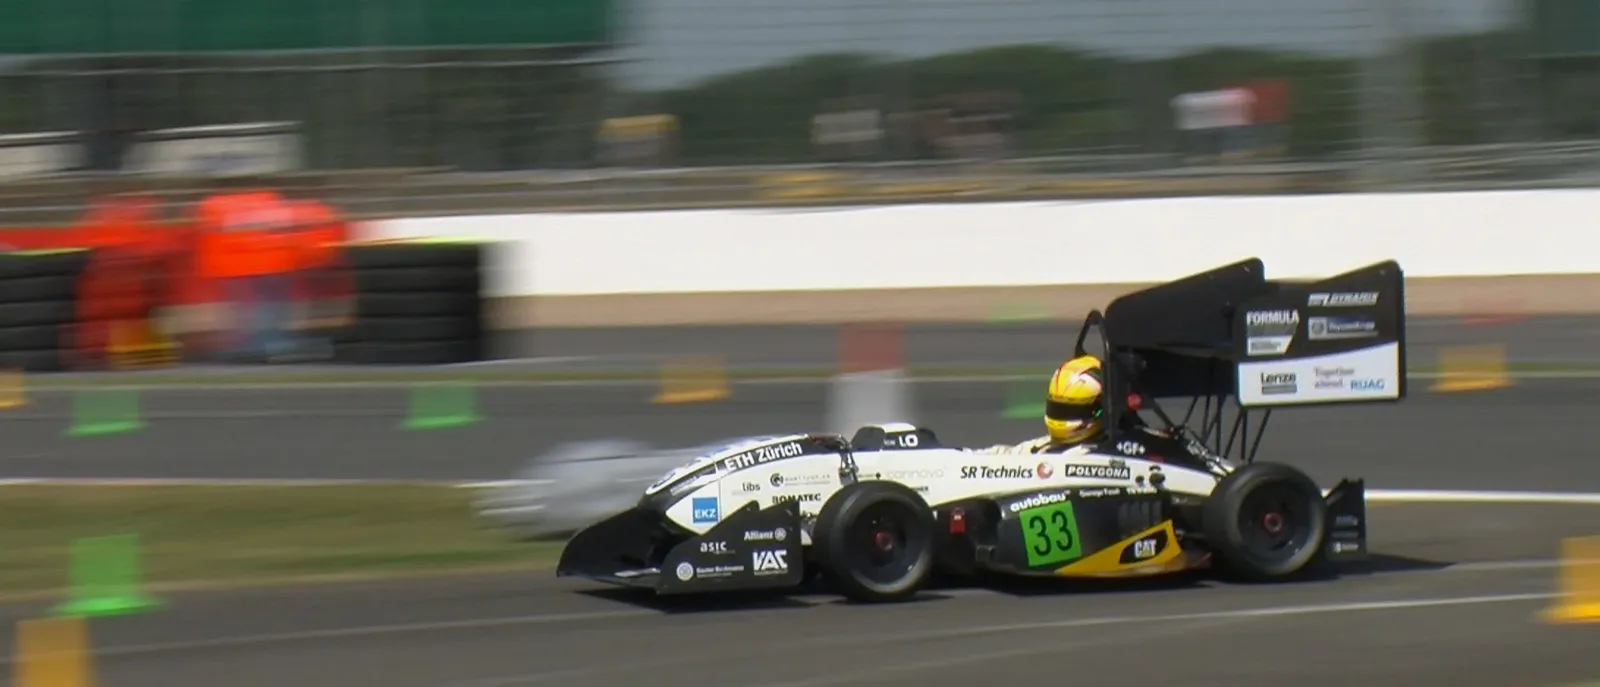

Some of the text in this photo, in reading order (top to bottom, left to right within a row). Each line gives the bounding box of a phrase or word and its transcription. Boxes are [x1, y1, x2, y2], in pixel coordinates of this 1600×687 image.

[1246, 309, 1299, 326] FORMULA
[1261, 372, 1296, 385] Lenze
[1350, 379, 1385, 391] RUAG
[724, 442, 803, 471] ETH Zürich
[960, 465, 1033, 479] SR Technics
[1066, 466, 1130, 479] POLYGONA
[1010, 493, 1066, 513] autobau
[694, 510, 717, 519] EKZ
[744, 530, 774, 540] Allianz
[1028, 510, 1074, 556] 33
[1134, 539, 1157, 558] CAT
[752, 549, 788, 571] VAC
